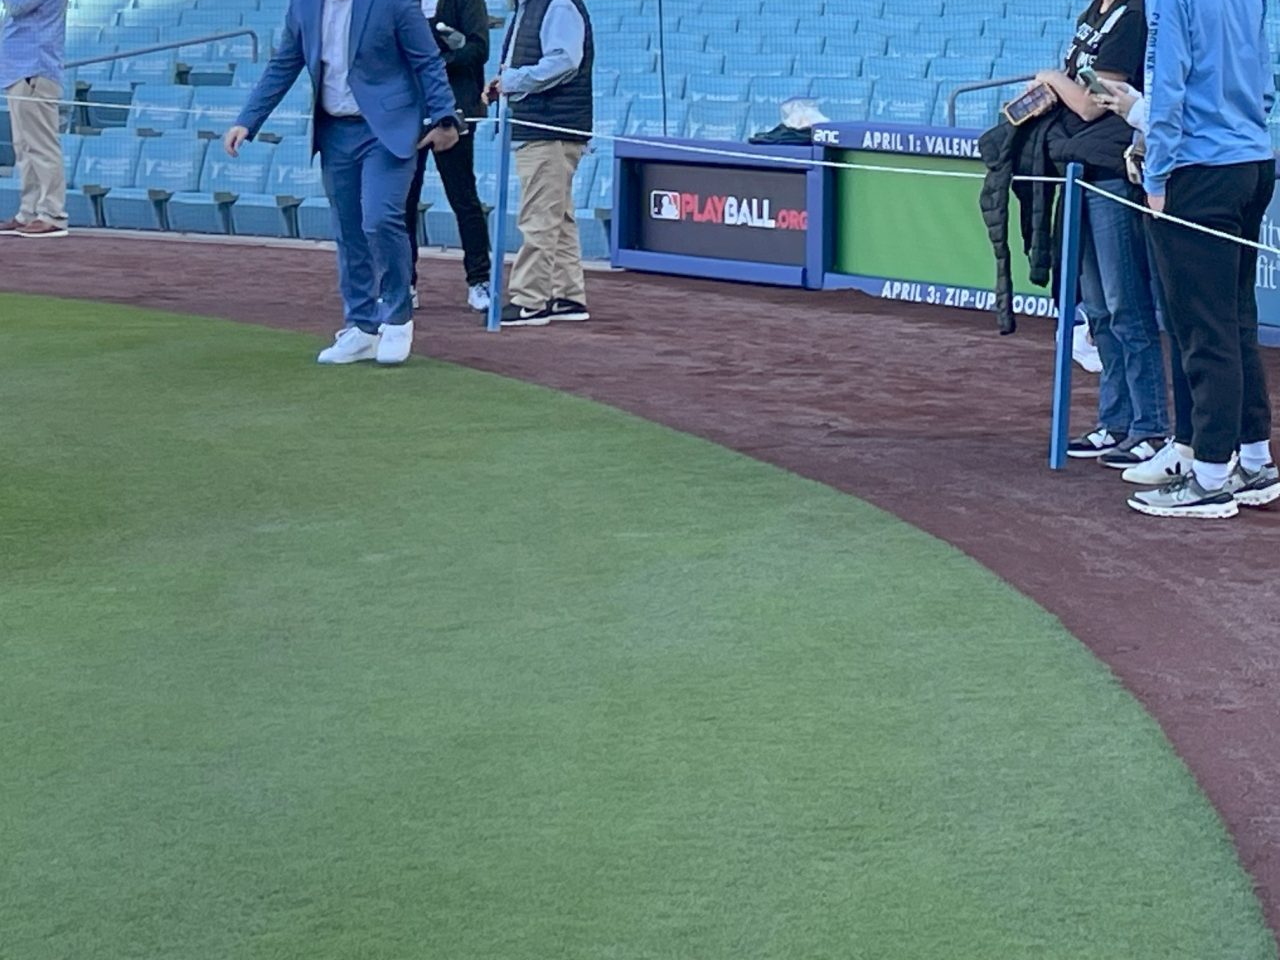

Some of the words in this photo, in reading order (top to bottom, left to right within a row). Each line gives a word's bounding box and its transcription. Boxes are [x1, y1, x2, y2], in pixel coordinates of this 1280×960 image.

[862, 131, 903, 151] APRIL
[908, 134, 921, 152] 1:
[881, 280, 922, 304] APRIL
[927, 287, 941, 305] 3:
[944, 288, 997, 311] ZIP-UP
[1012, 295, 1060, 319] OODI
